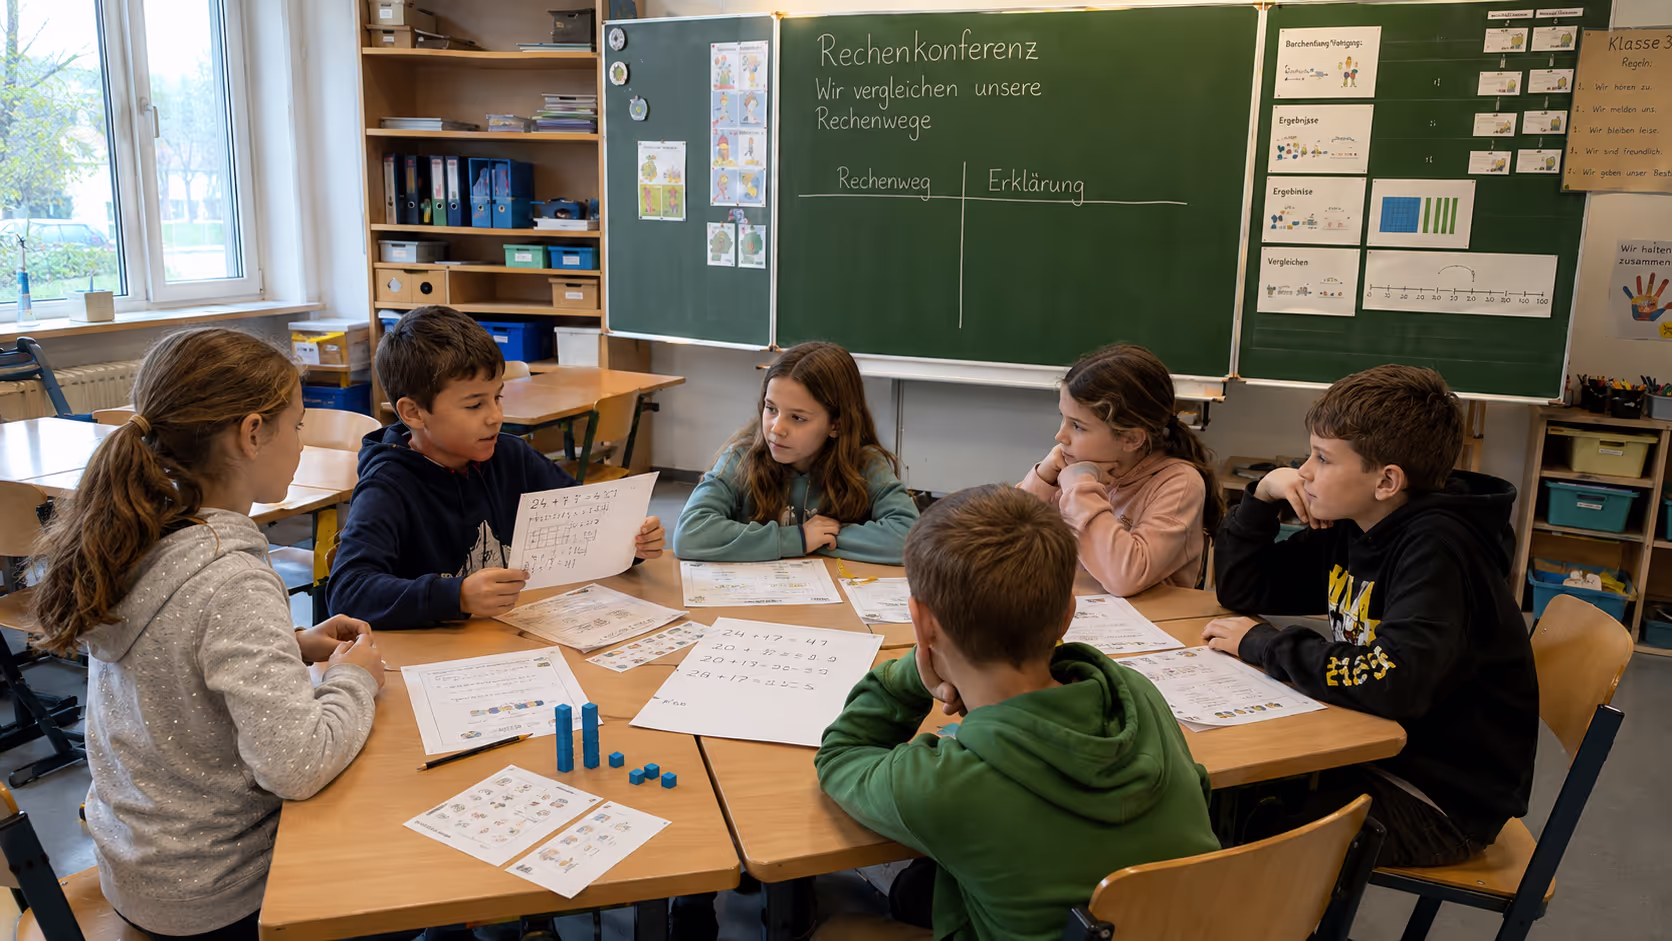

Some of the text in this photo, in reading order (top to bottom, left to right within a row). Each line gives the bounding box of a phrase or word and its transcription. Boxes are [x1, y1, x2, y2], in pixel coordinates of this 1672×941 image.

[1608, 34, 1672, 51] Klasse 3
[817, 29, 1039, 67] Rechenkonferenz
[1595, 83, 1608, 91] Wir
[815, 75, 1042, 111] Wir vergleichen unsere
[1592, 105, 1606, 113] Wir
[1610, 105, 1637, 113] melden
[815, 106, 932, 142] Rechenwege
[1589, 126, 1603, 134] Wir
[1607, 126, 1635, 134] bleiben
[1585, 147, 1599, 155] Wir
[1603, 147, 1619, 155] sind
[1582, 168, 1596, 176] Wir
[1600, 168, 1622, 179] geben
[836, 165, 1085, 207] Rechenweg Erklärung
[1620, 244, 1638, 253] Wir
[1267, 257, 1309, 268] Vergleichen
[722, 629, 745, 638] 24
[711, 643, 736, 651] 20
[699, 655, 725, 663] 20
